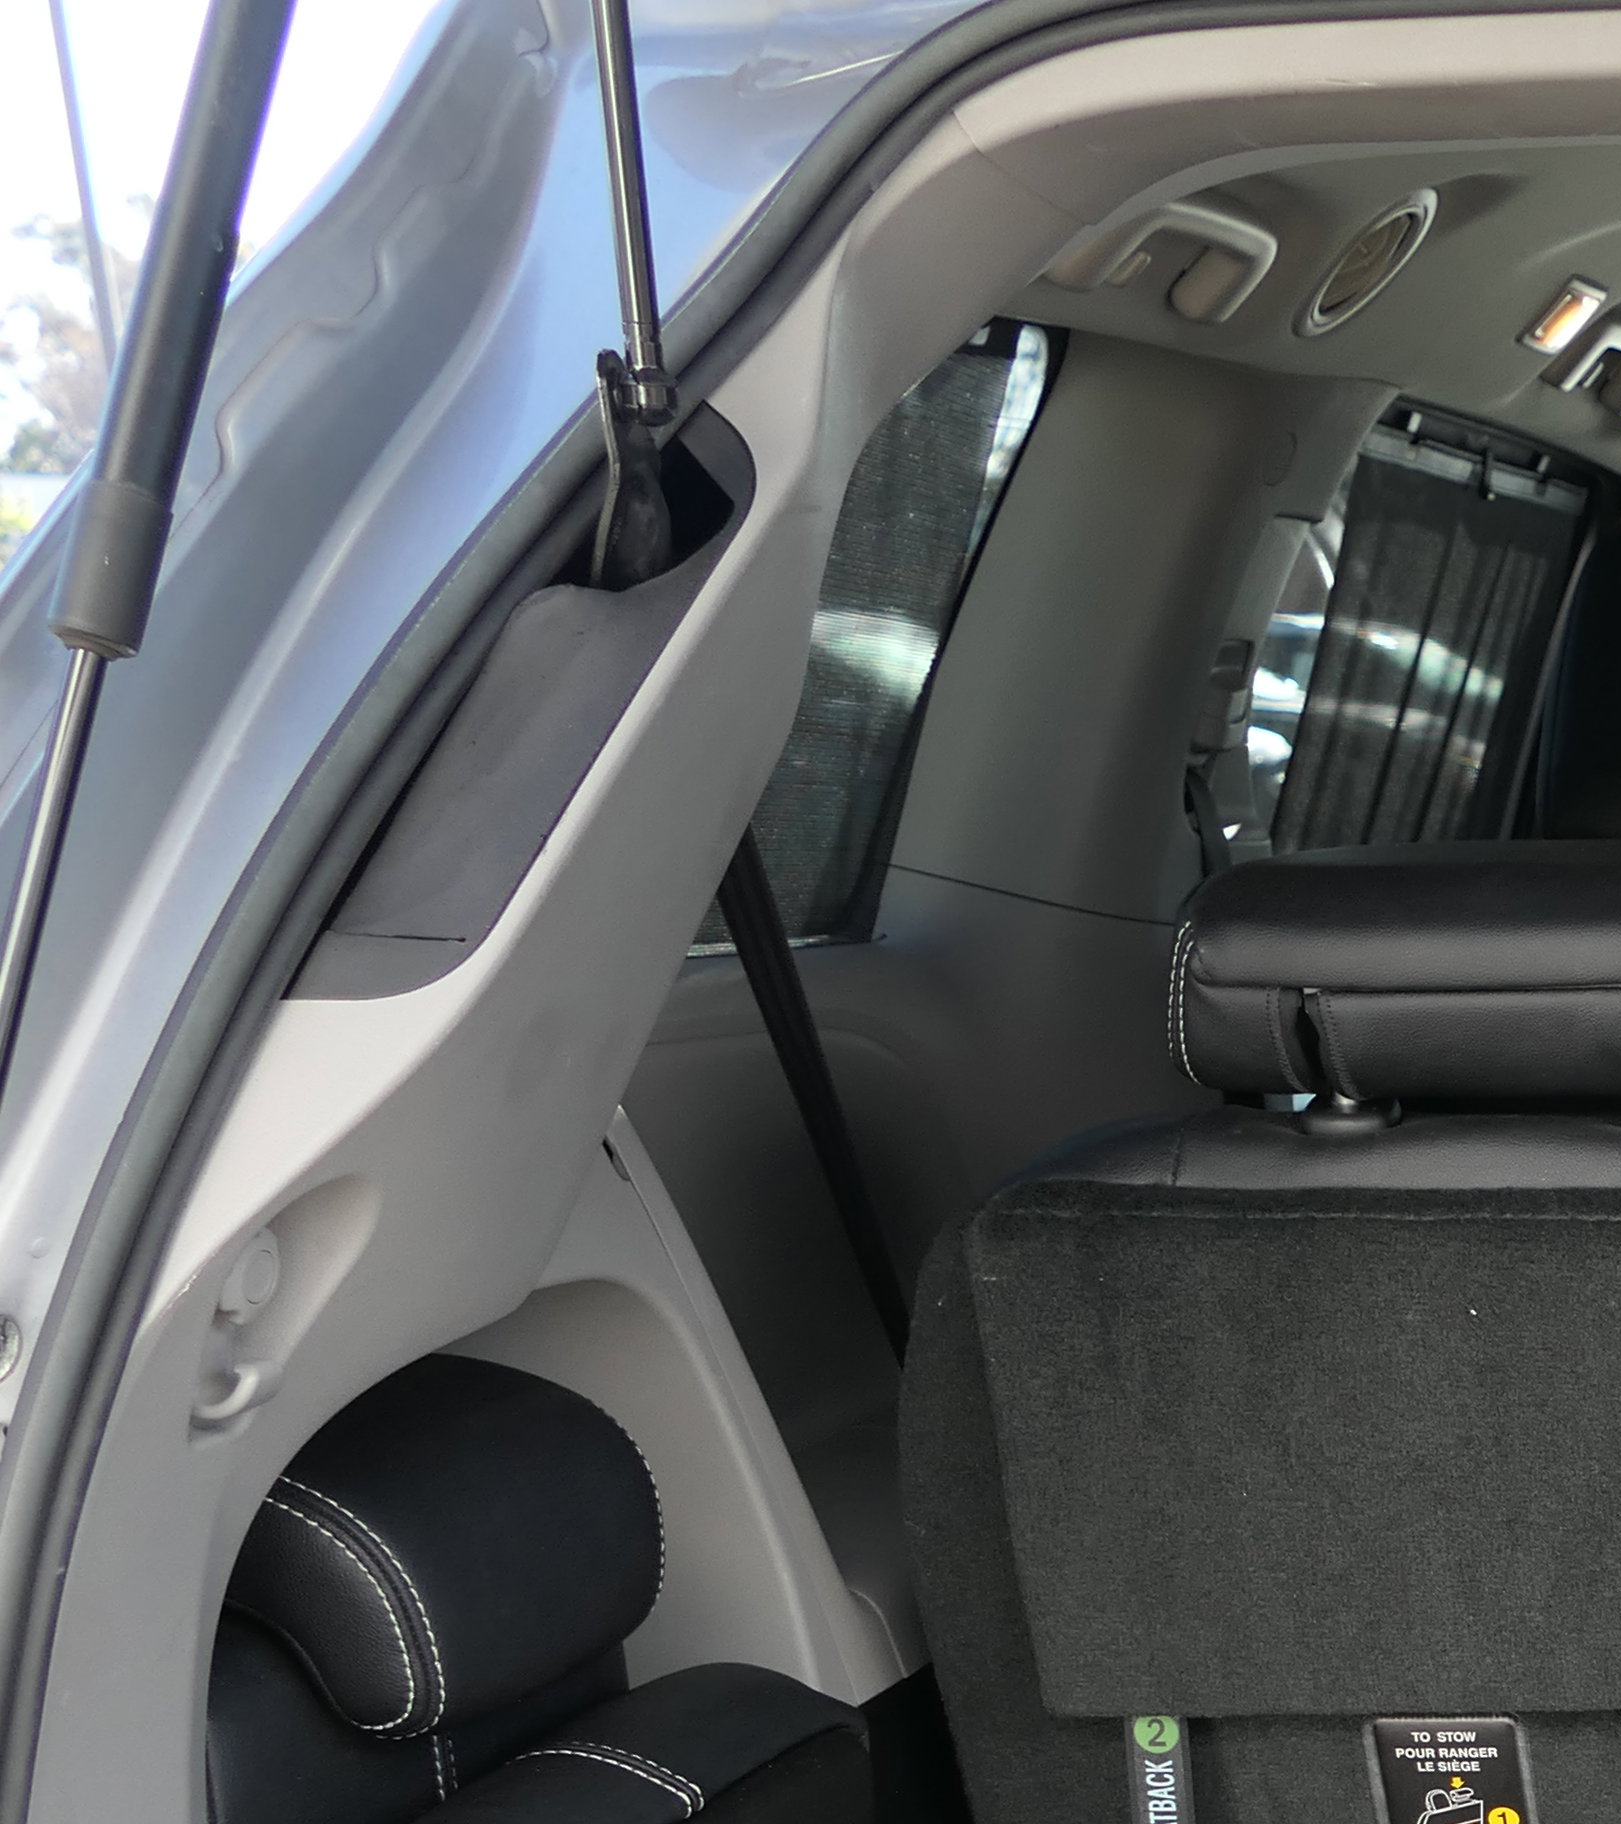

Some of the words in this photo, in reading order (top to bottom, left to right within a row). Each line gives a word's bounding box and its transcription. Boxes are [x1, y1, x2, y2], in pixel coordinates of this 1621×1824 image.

[1147, 1718, 1167, 1747] 2
[1411, 1732, 1431, 1743] TO
[1437, 1731, 1476, 1742] STOW
[1395, 1748, 1436, 1758] POUR
[1438, 1747, 1498, 1758] RANGER
[1417, 1762, 1435, 1772] LE
[1438, 1759, 1481, 1772] SIÈGE
